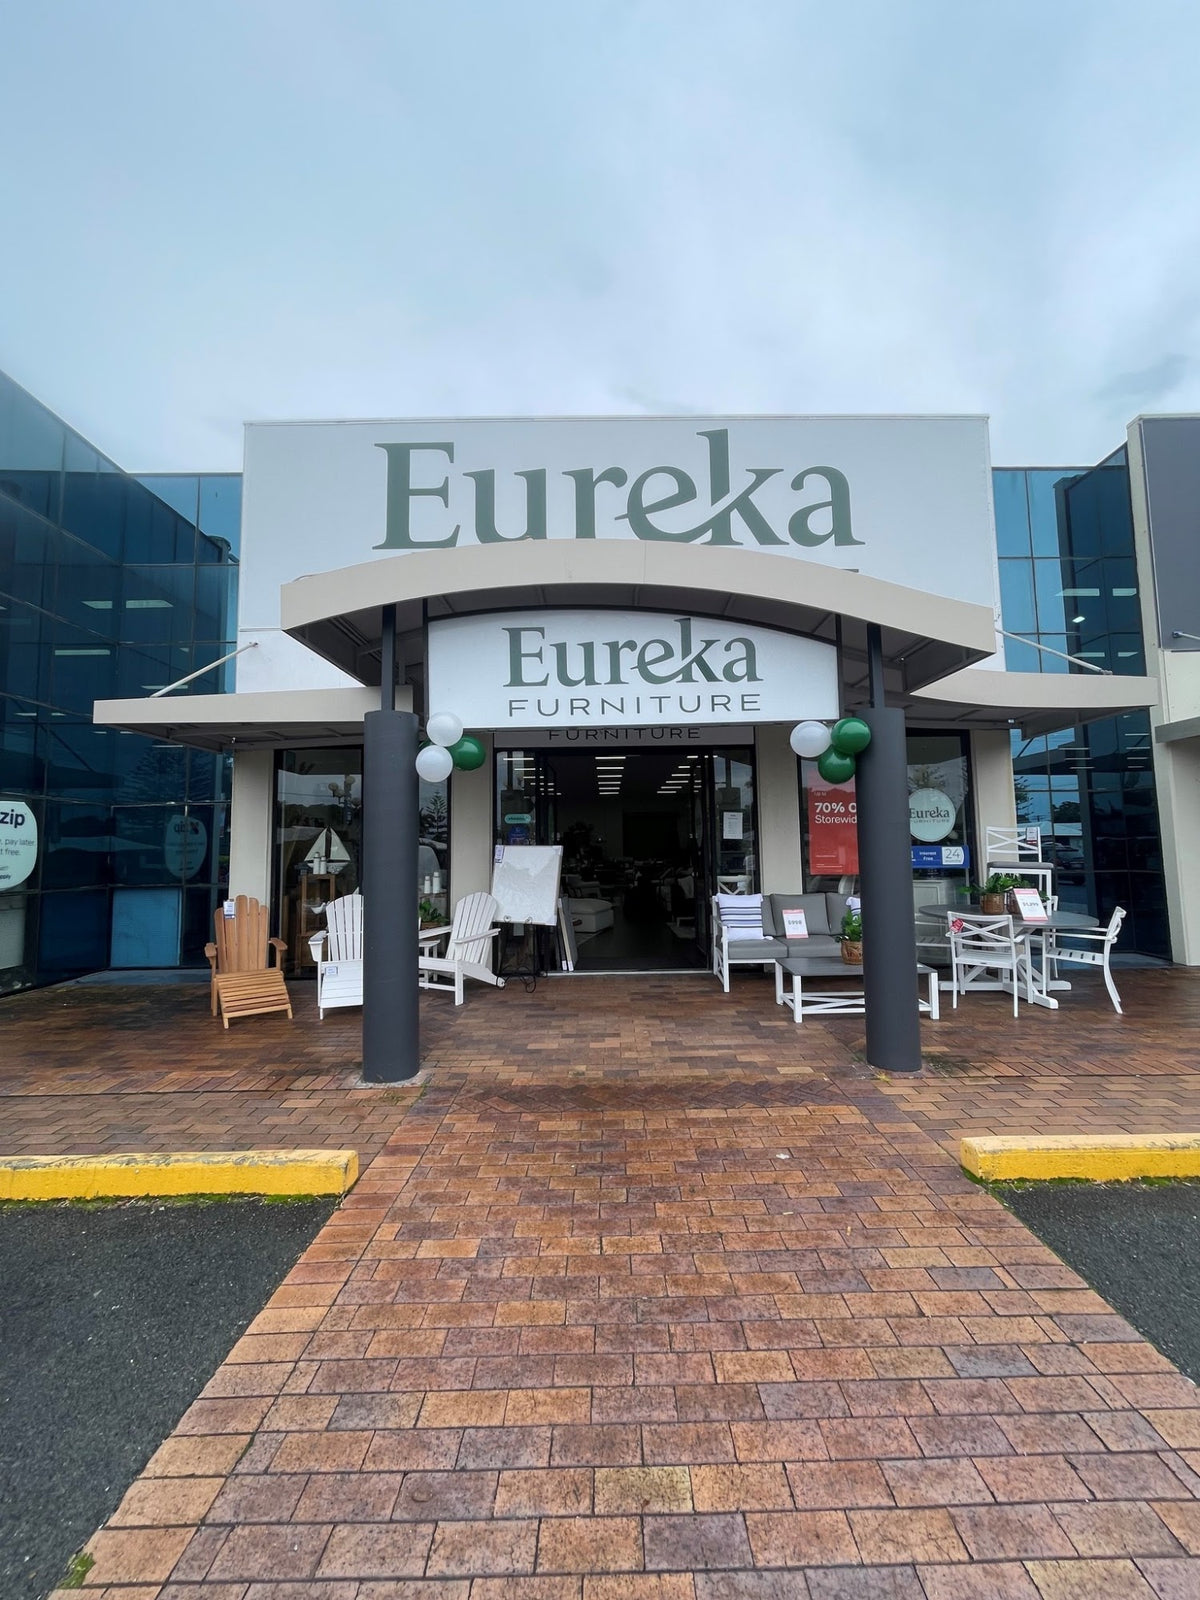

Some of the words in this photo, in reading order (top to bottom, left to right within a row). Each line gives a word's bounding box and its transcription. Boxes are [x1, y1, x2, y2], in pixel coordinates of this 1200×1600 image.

[372, 428, 866, 549] Eureka
[502, 617, 764, 687] Eureka
[508, 694, 761, 717] FURNITURE
[549, 727, 702, 741] FURNITURE
[814, 802, 845, 813] 70%
[909, 806, 950, 819] Eureka
[0, 808, 25, 829] zip
[814, 814, 858, 824] Storewid
[945, 848, 961, 859] 24
